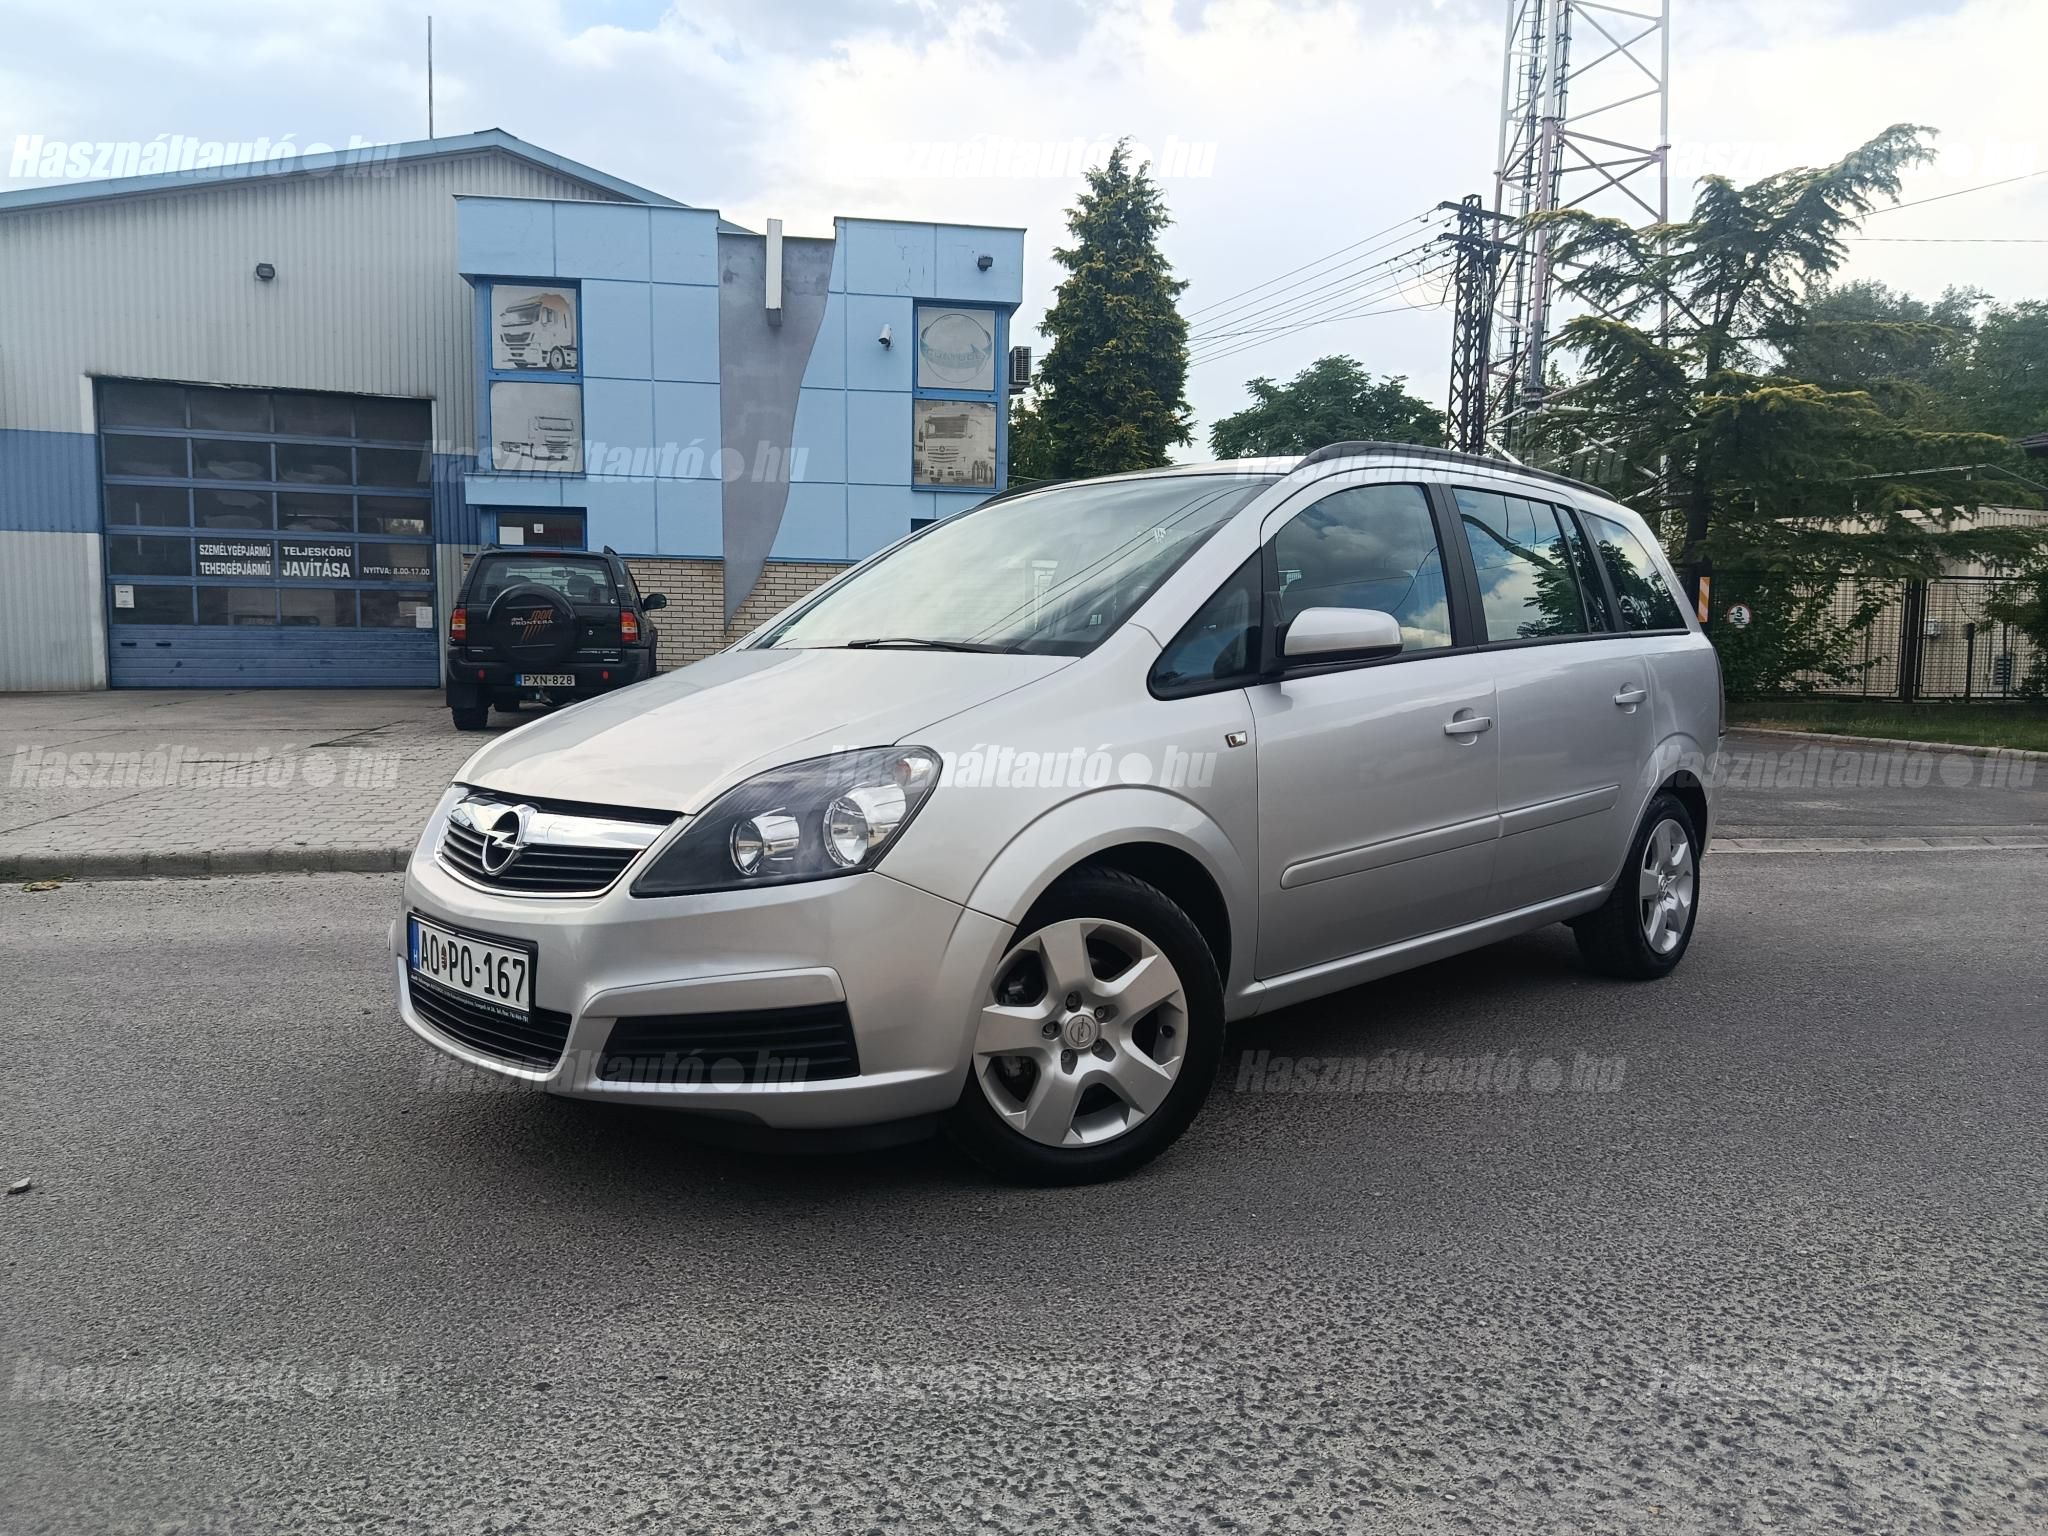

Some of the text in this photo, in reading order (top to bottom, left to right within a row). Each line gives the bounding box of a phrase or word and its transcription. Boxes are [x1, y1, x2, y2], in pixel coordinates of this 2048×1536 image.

[282, 558, 351, 577] JAVÍTÁSA
[363, 566, 391, 575] NYITVA:
[523, 674, 573, 685] PXN-828
